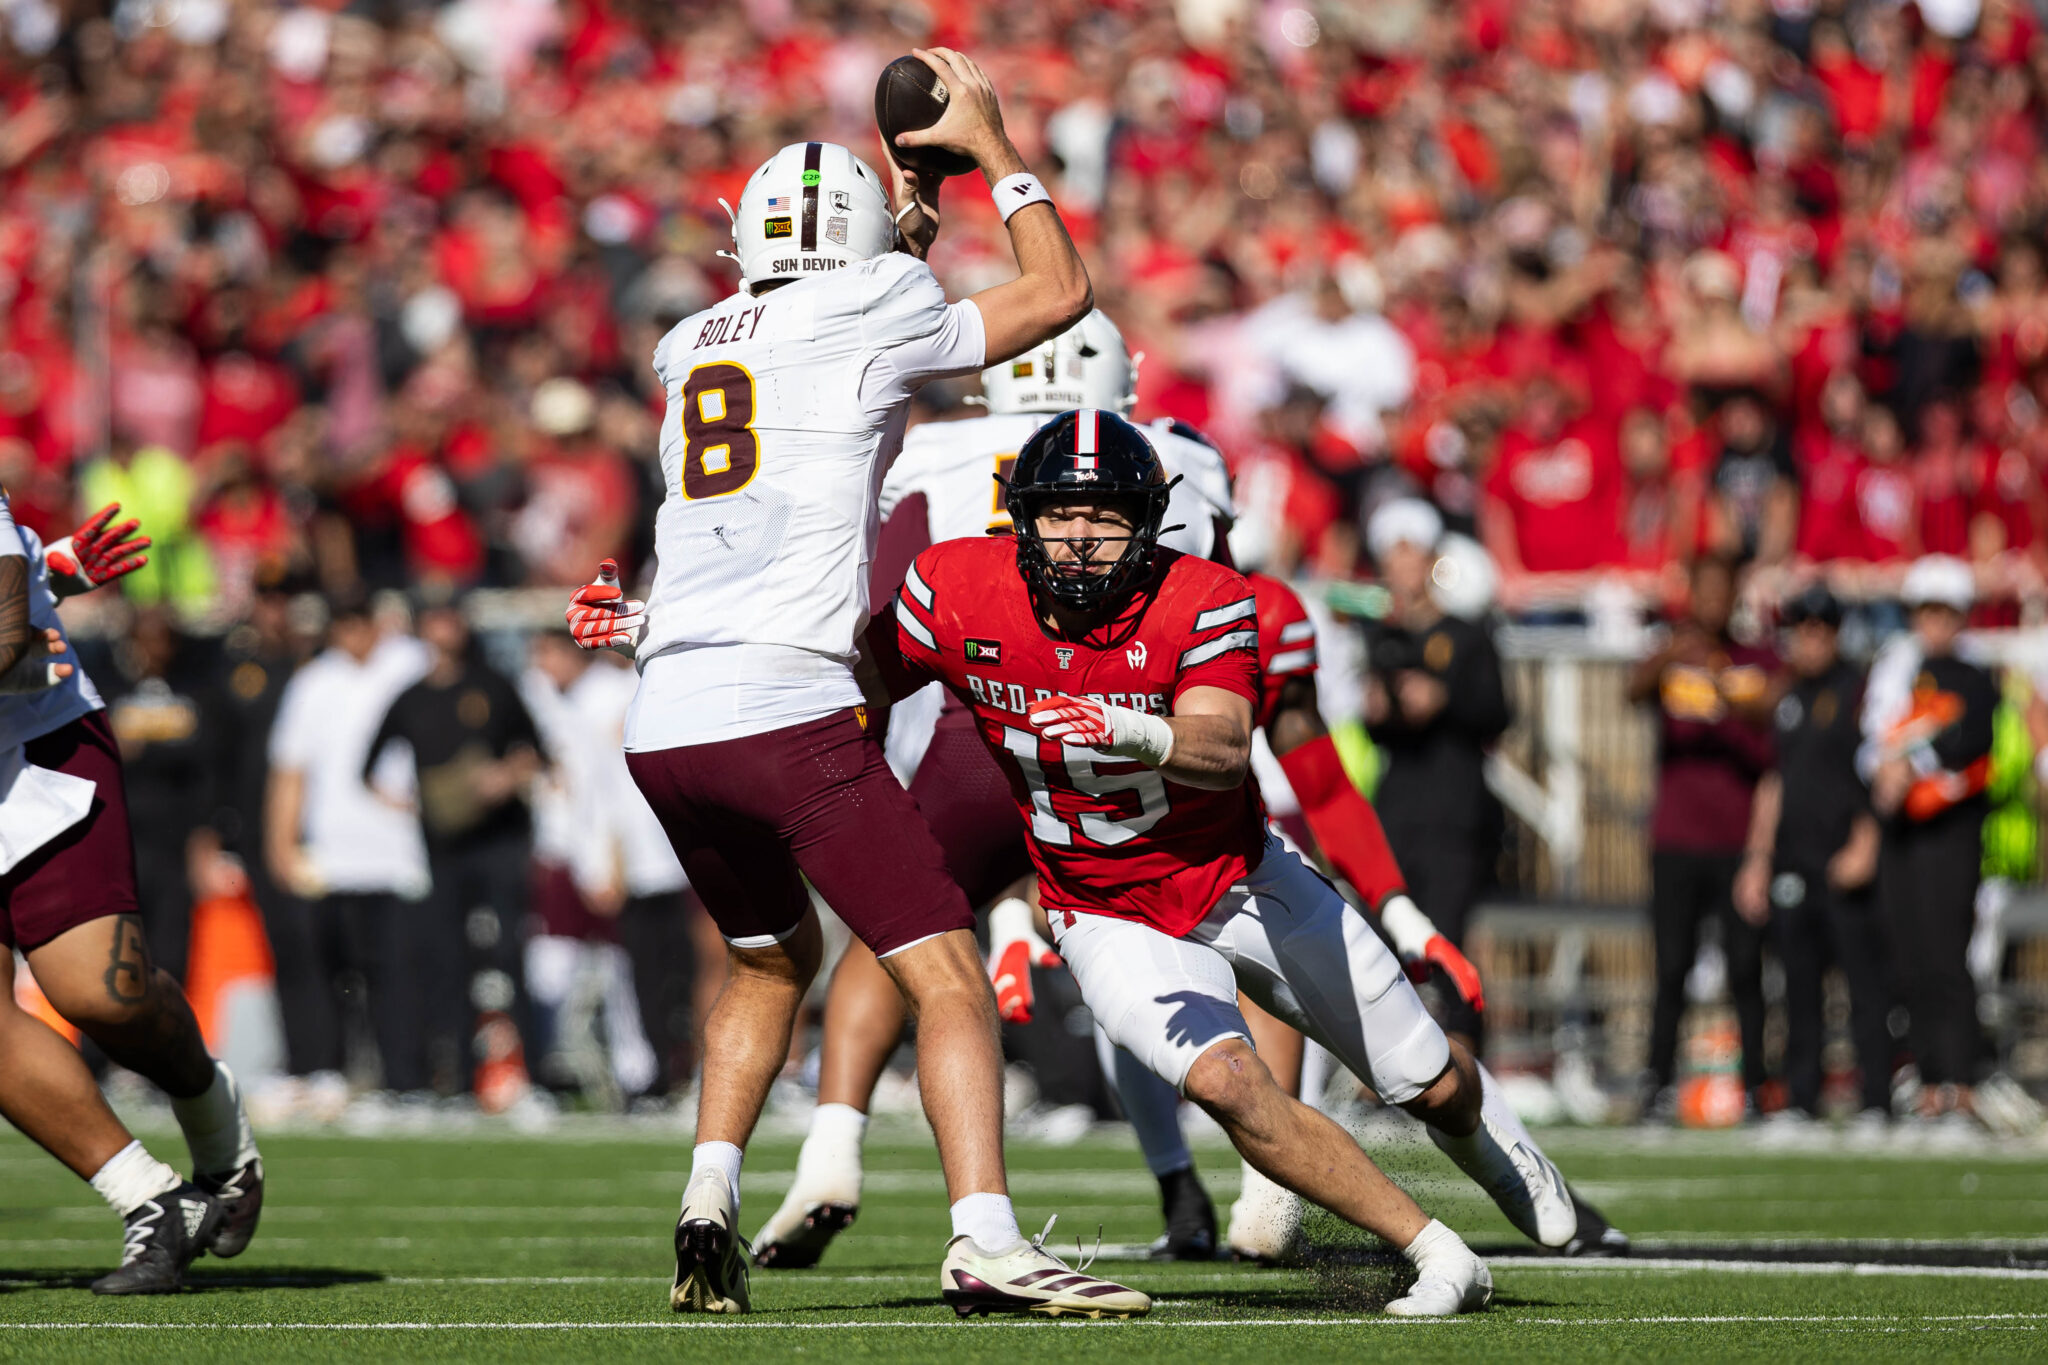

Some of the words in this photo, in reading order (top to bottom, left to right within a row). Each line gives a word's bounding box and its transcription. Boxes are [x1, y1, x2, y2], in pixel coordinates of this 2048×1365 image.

[772, 259, 798, 273] SUN
[692, 304, 767, 350] BOLEY
[681, 360, 760, 501] 8
[966, 674, 1027, 715] RED
[1003, 725, 1171, 846] 15
